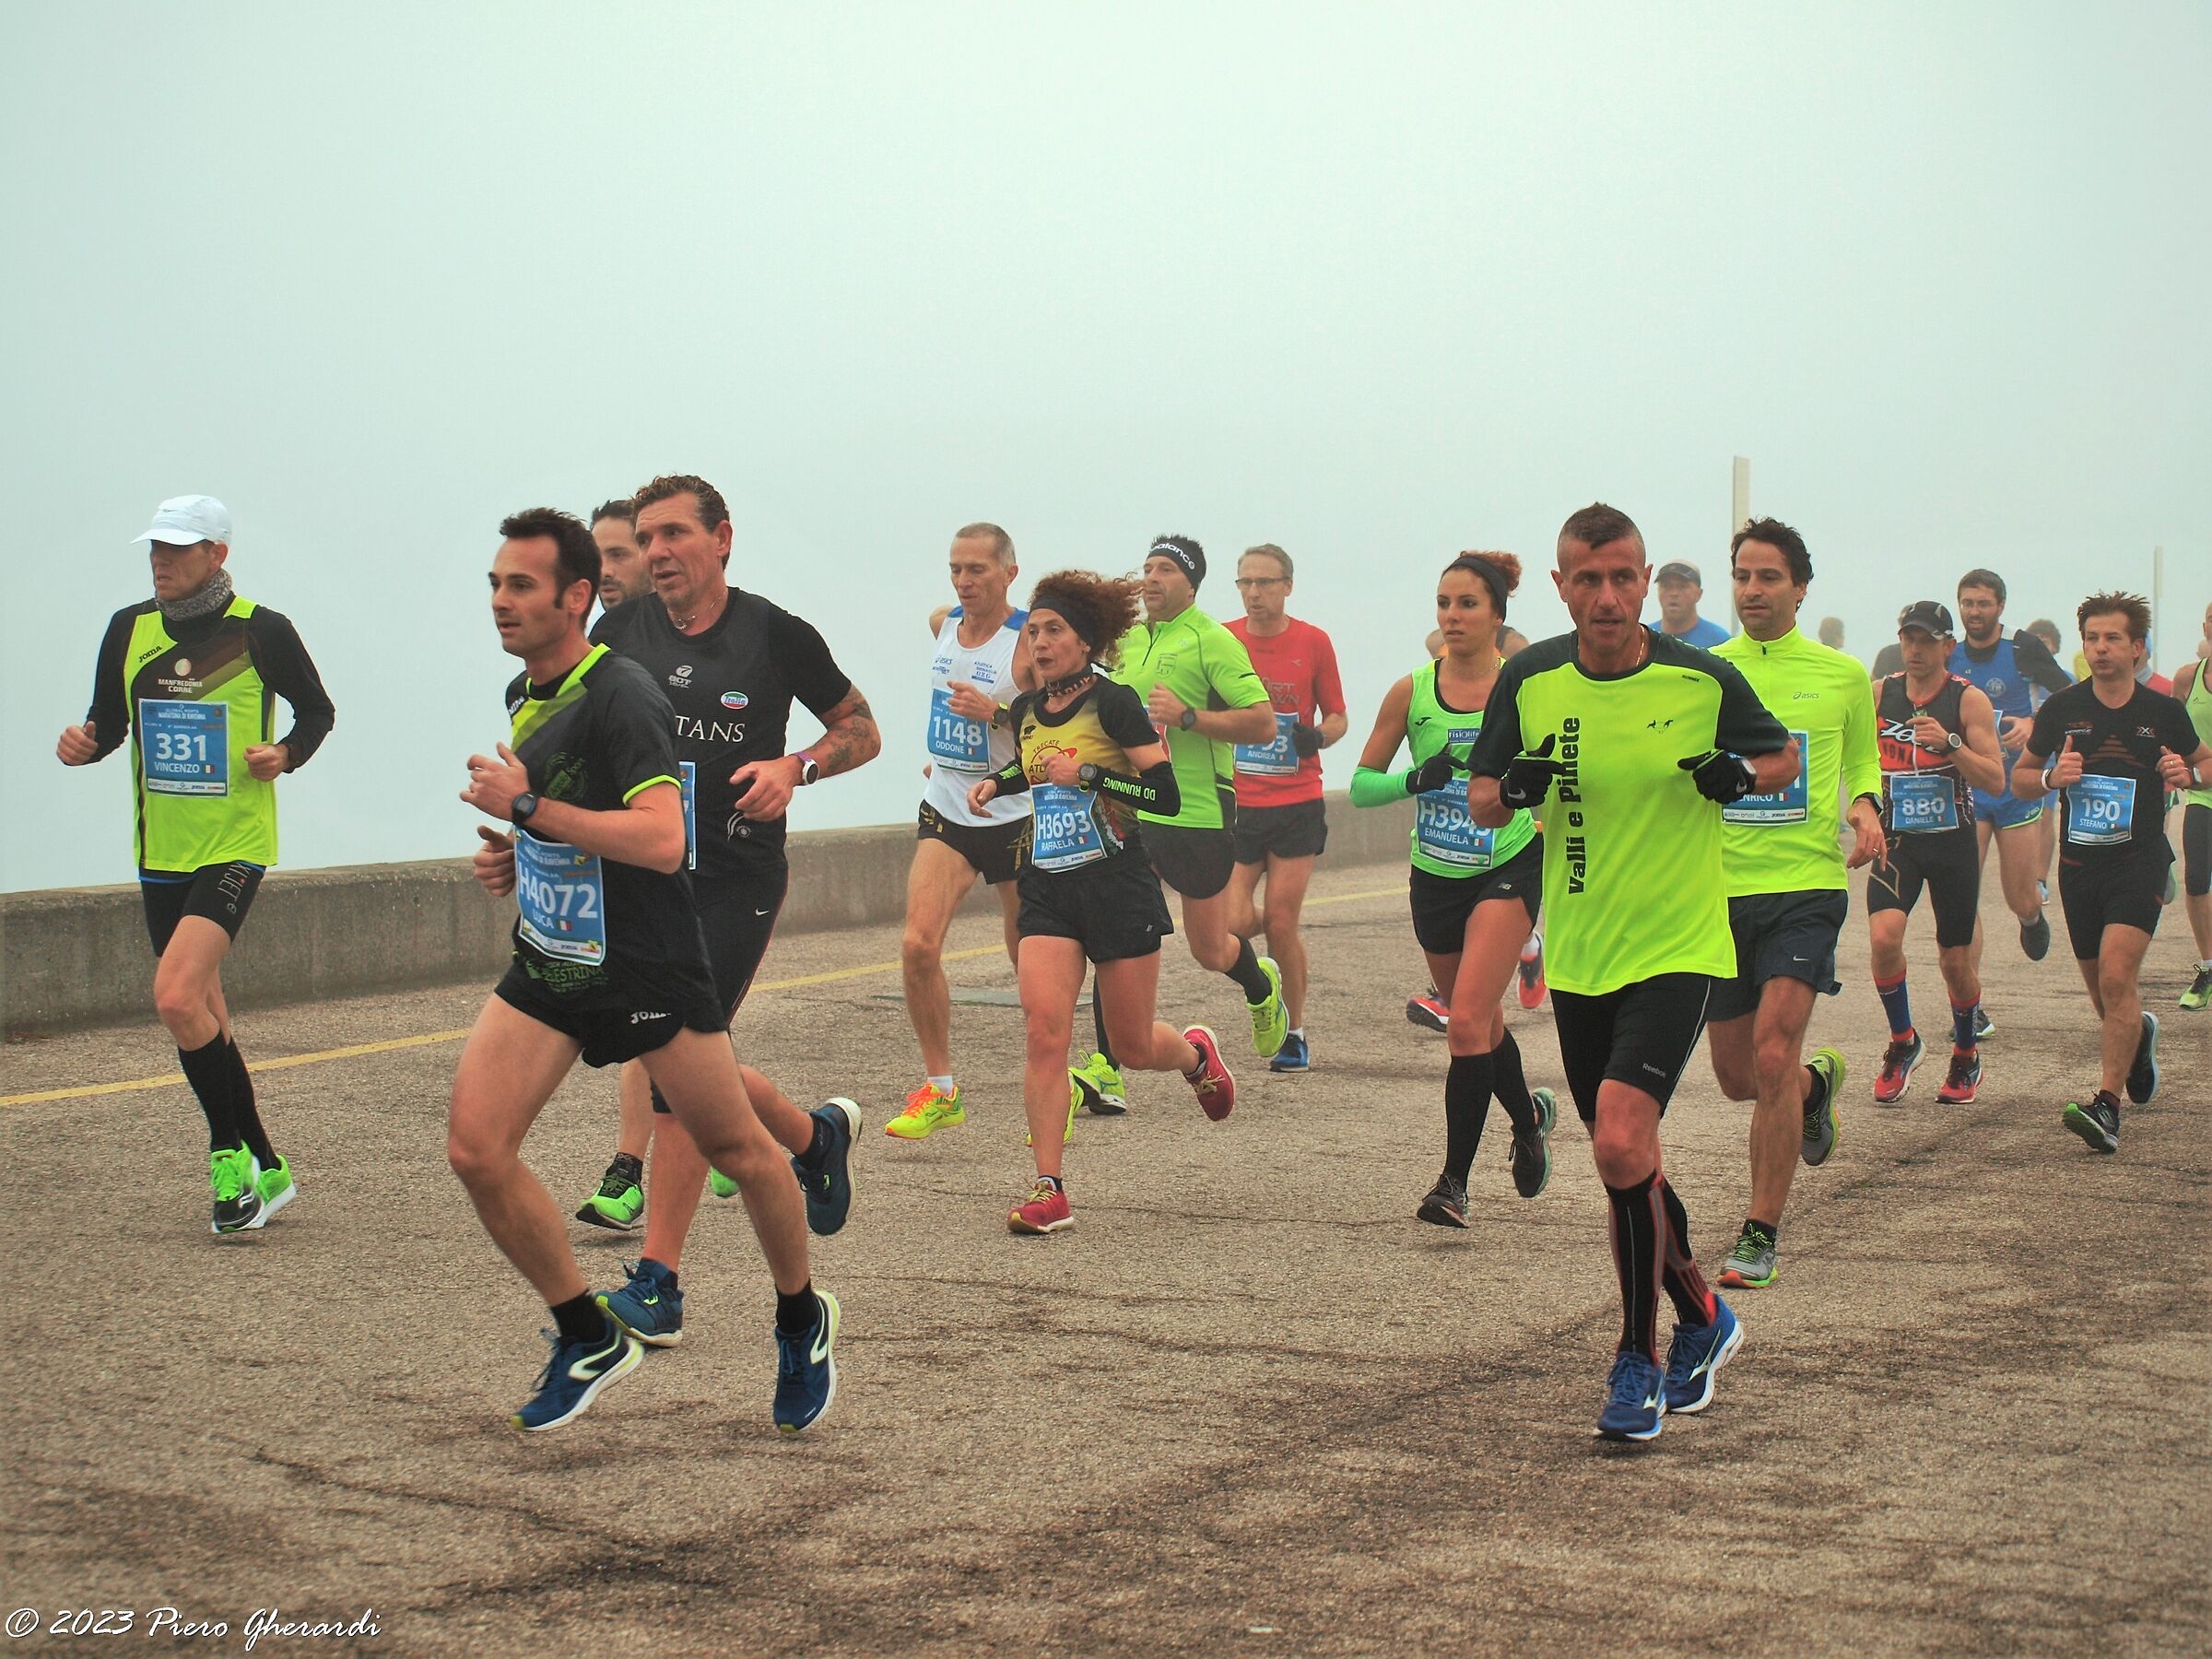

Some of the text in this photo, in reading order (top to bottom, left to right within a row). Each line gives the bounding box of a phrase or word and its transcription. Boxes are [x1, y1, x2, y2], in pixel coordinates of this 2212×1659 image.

[158, 678, 203, 688] MANFREDONIA
[934, 715, 982, 747] 1148
[156, 733, 206, 761] 331
[935, 740, 965, 754] ODDONE
[1033, 739, 1060, 753] TRECATE
[155, 761, 200, 773] VINCENZO
[1102, 777, 1157, 802] DD RUNNING
[1740, 794, 1773, 802] NRICO
[1558, 717, 1586, 895] Valli e Pinete
[1901, 796, 1946, 817] 880
[2081, 797, 2121, 821] 190
[1037, 810, 1091, 841] H3693
[2079, 818, 2108, 830] STEFANO
[1041, 839, 1076, 852] RAFFAELA
[1424, 827, 1469, 845] EMANUELA
[519, 861, 599, 919] H4072
[533, 908, 555, 930] LUCA
